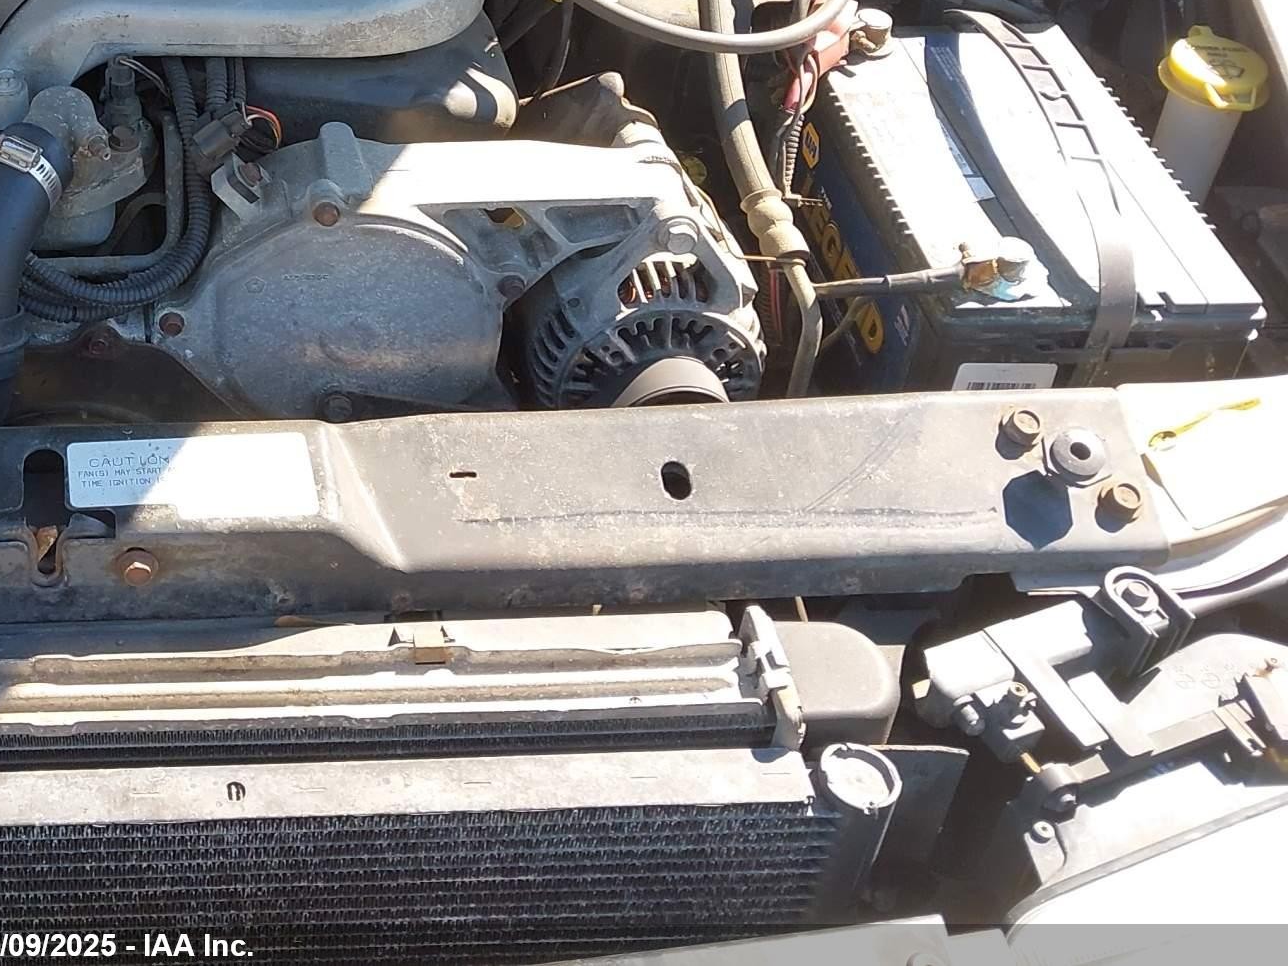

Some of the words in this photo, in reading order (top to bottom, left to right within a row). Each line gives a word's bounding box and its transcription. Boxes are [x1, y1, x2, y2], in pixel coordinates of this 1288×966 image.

[89, 455, 170, 468] CAUTION
[78, 469, 109, 478] FAN(S)
[114, 468, 131, 477] MAY
[135, 467, 162, 475] START
[81, 479, 103, 488] TIME
[109, 477, 152, 486] IGNITION
